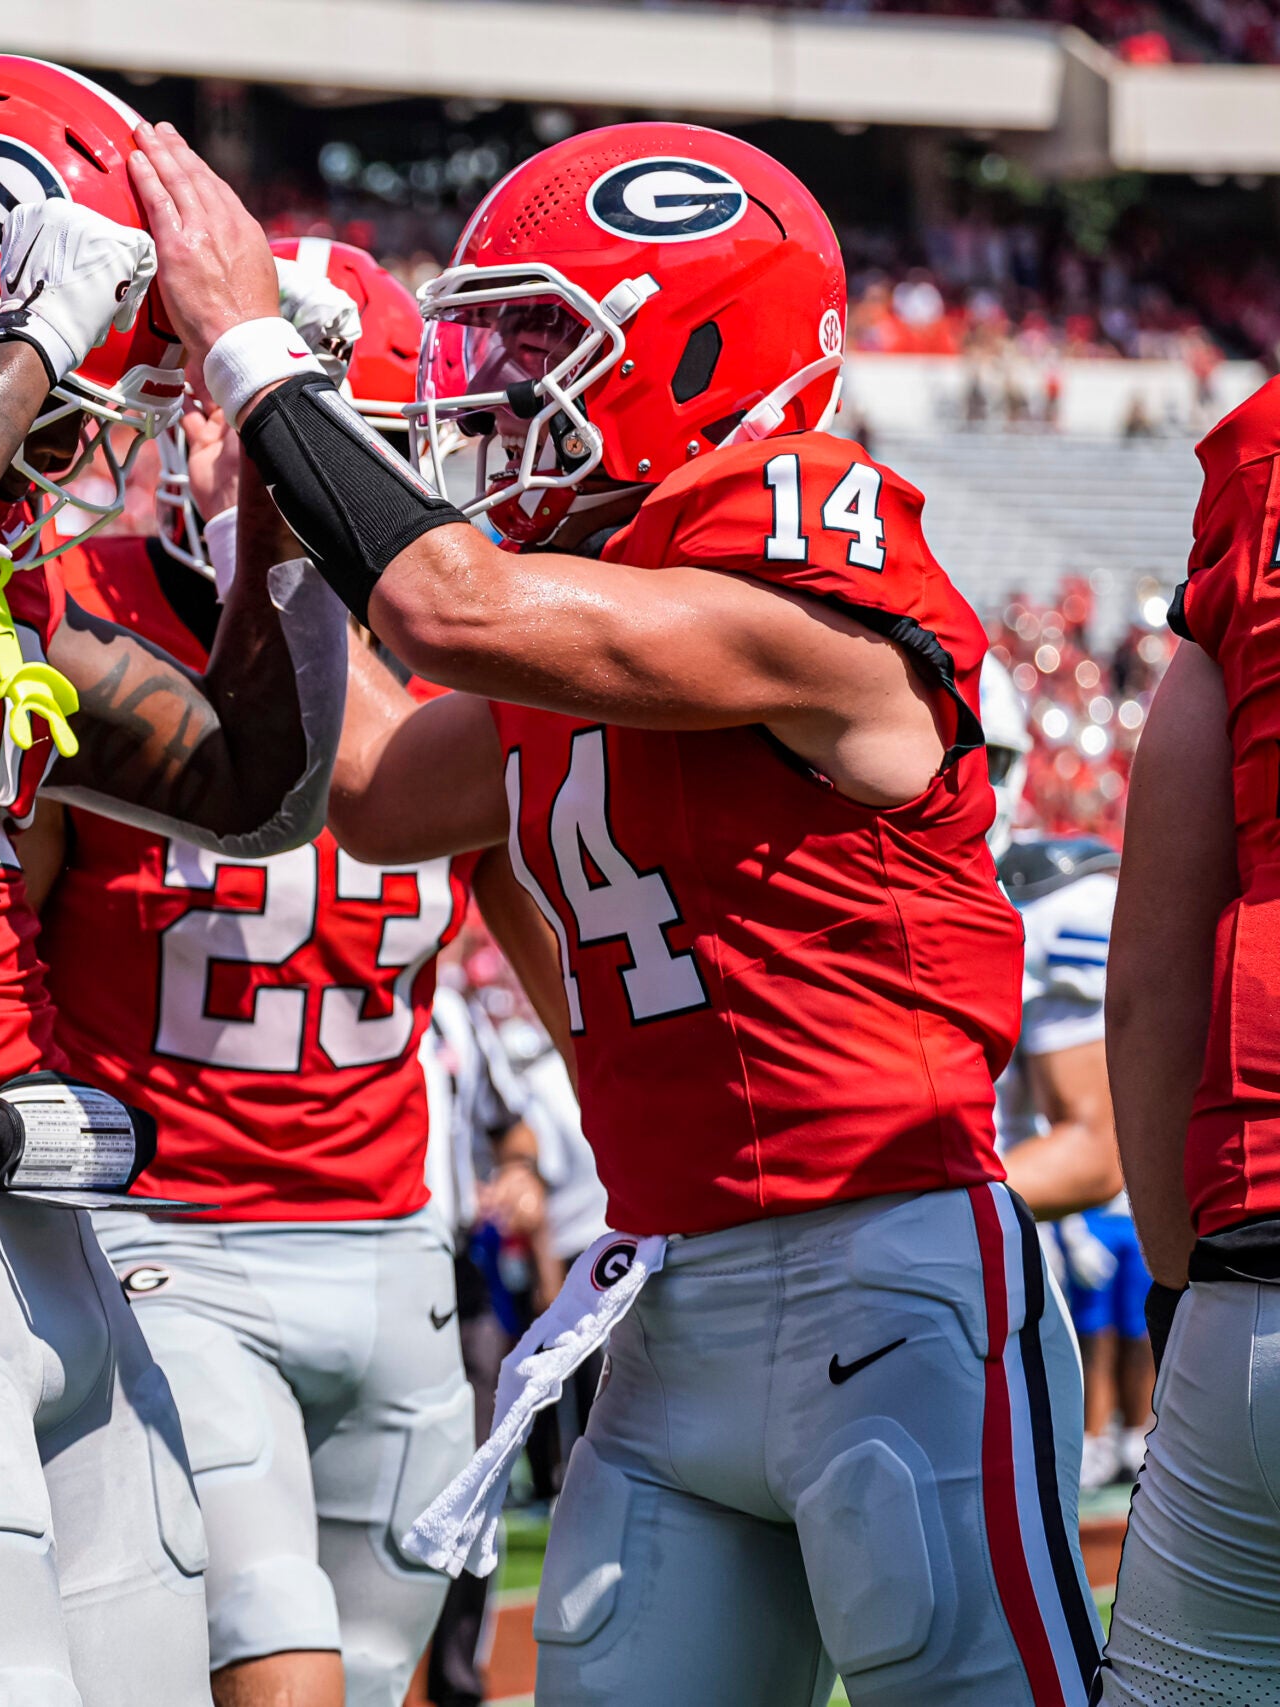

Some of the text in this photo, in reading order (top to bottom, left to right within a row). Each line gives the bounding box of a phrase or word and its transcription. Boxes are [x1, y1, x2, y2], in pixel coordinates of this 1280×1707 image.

[590, 159, 744, 239] G
[823, 315, 839, 351] SEC
[762, 453, 887, 574] 14
[153, 838, 455, 1074] 23
[121, 1267, 169, 1292] G
